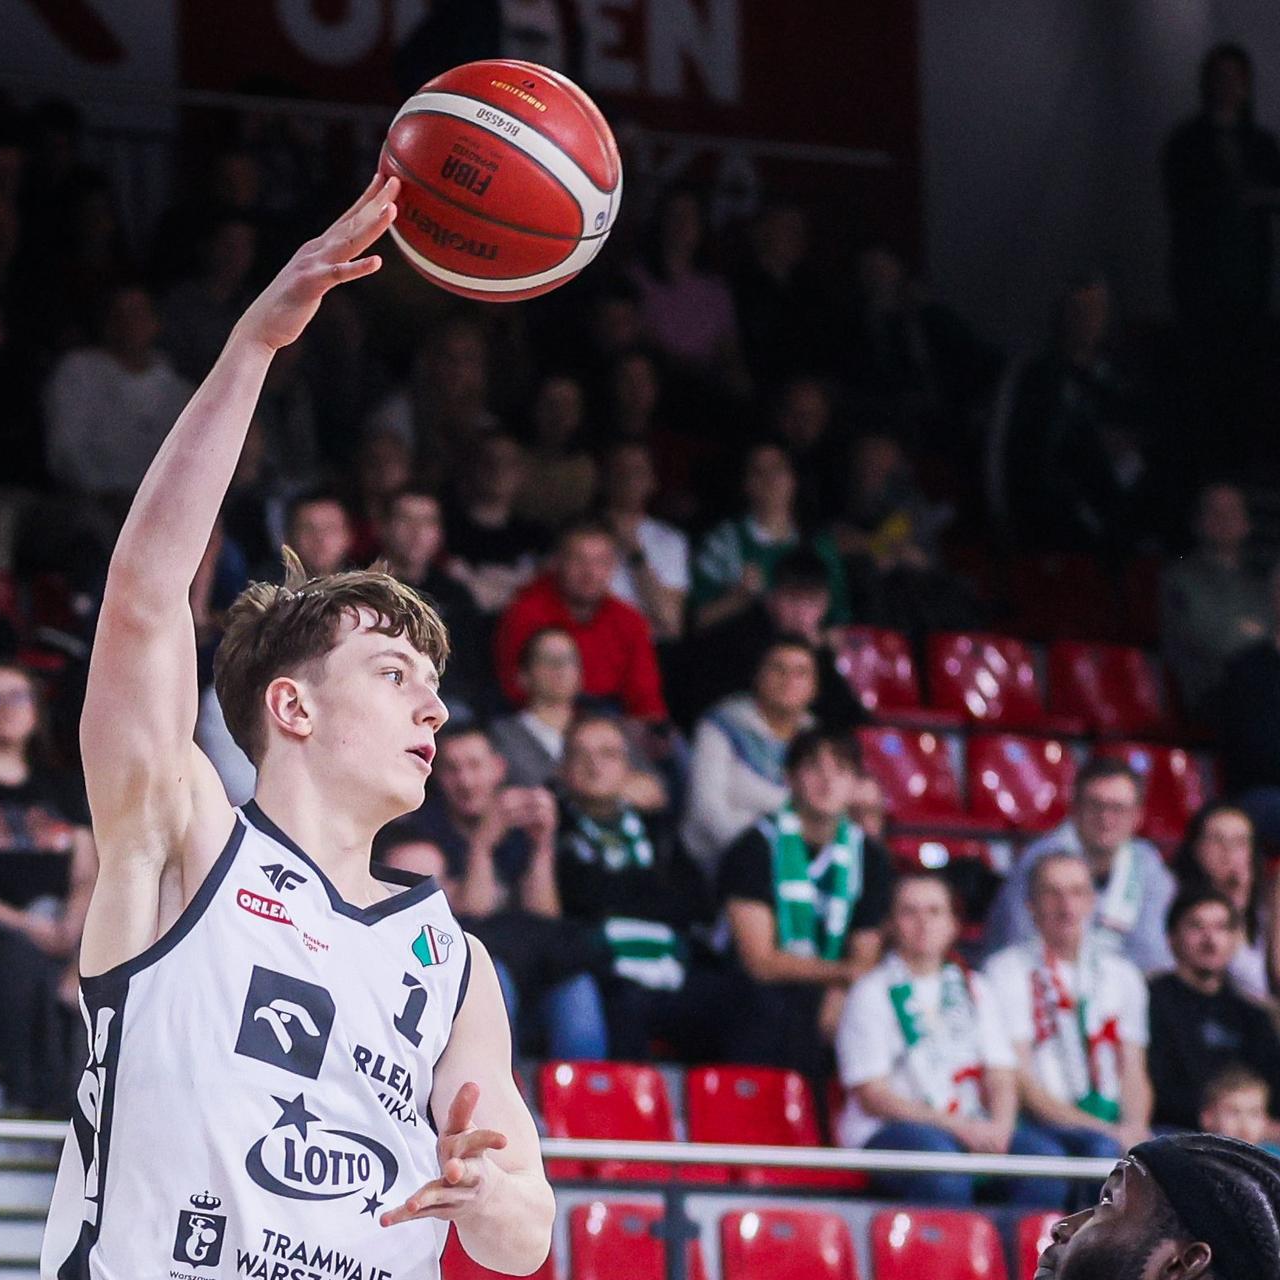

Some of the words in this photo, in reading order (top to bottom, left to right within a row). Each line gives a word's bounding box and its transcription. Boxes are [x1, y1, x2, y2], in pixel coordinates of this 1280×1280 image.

[440, 155, 494, 197] FIBA
[404, 201, 500, 261] molten
[259, 863, 308, 893] 4F
[393, 971, 428, 1048] 1
[352, 1044, 414, 1103] RLEN
[284, 1137, 371, 1186] LOTTO
